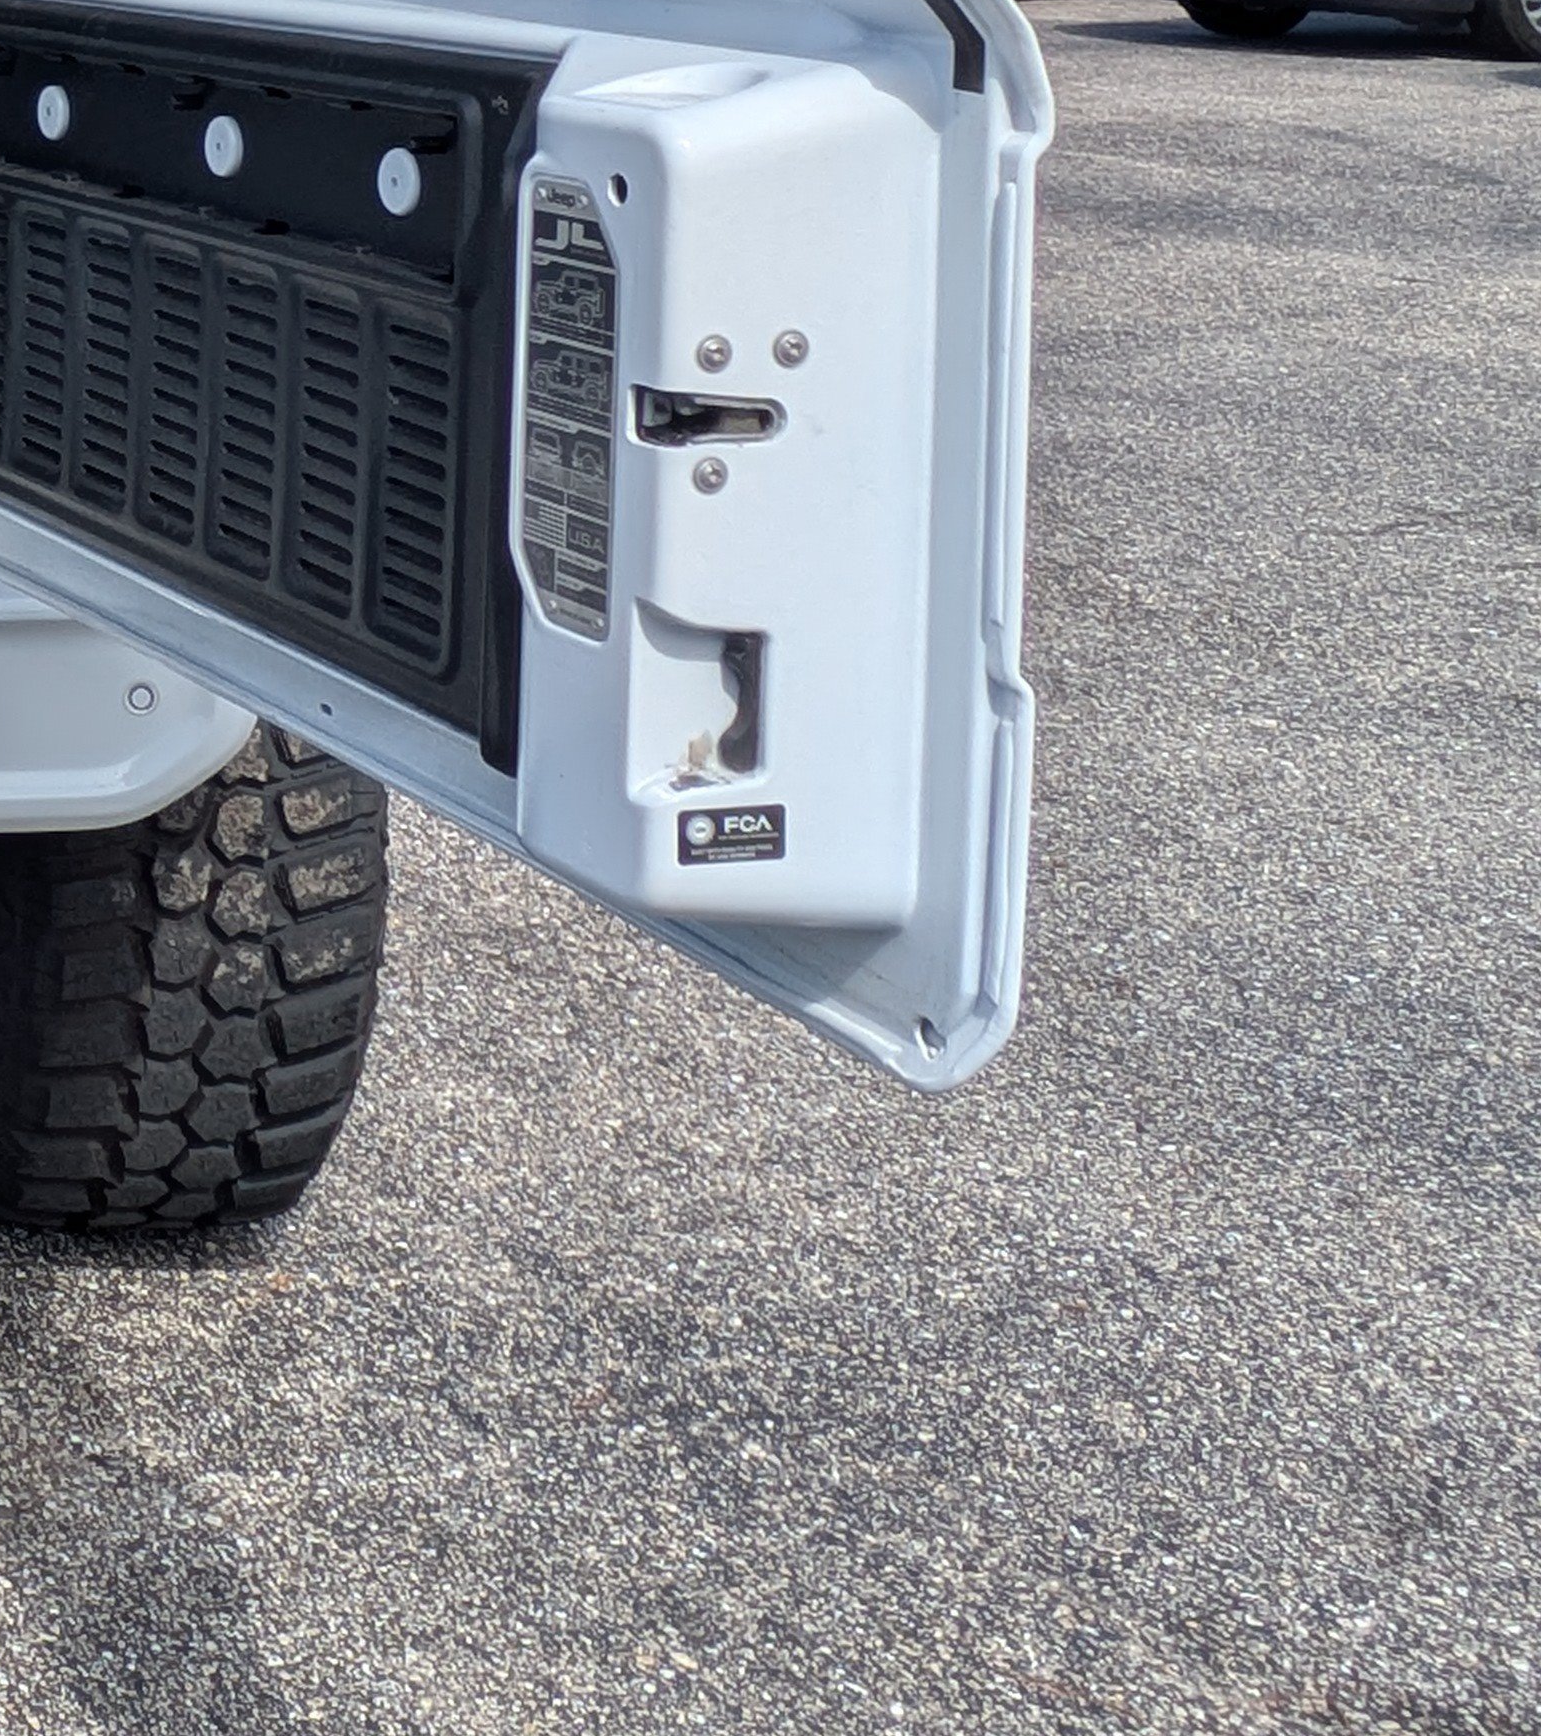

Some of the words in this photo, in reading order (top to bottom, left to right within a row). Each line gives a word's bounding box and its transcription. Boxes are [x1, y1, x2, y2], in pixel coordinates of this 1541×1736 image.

[547, 188, 576, 207] Jeep
[535, 219, 605, 250] JL
[724, 815, 774, 834] FCA
